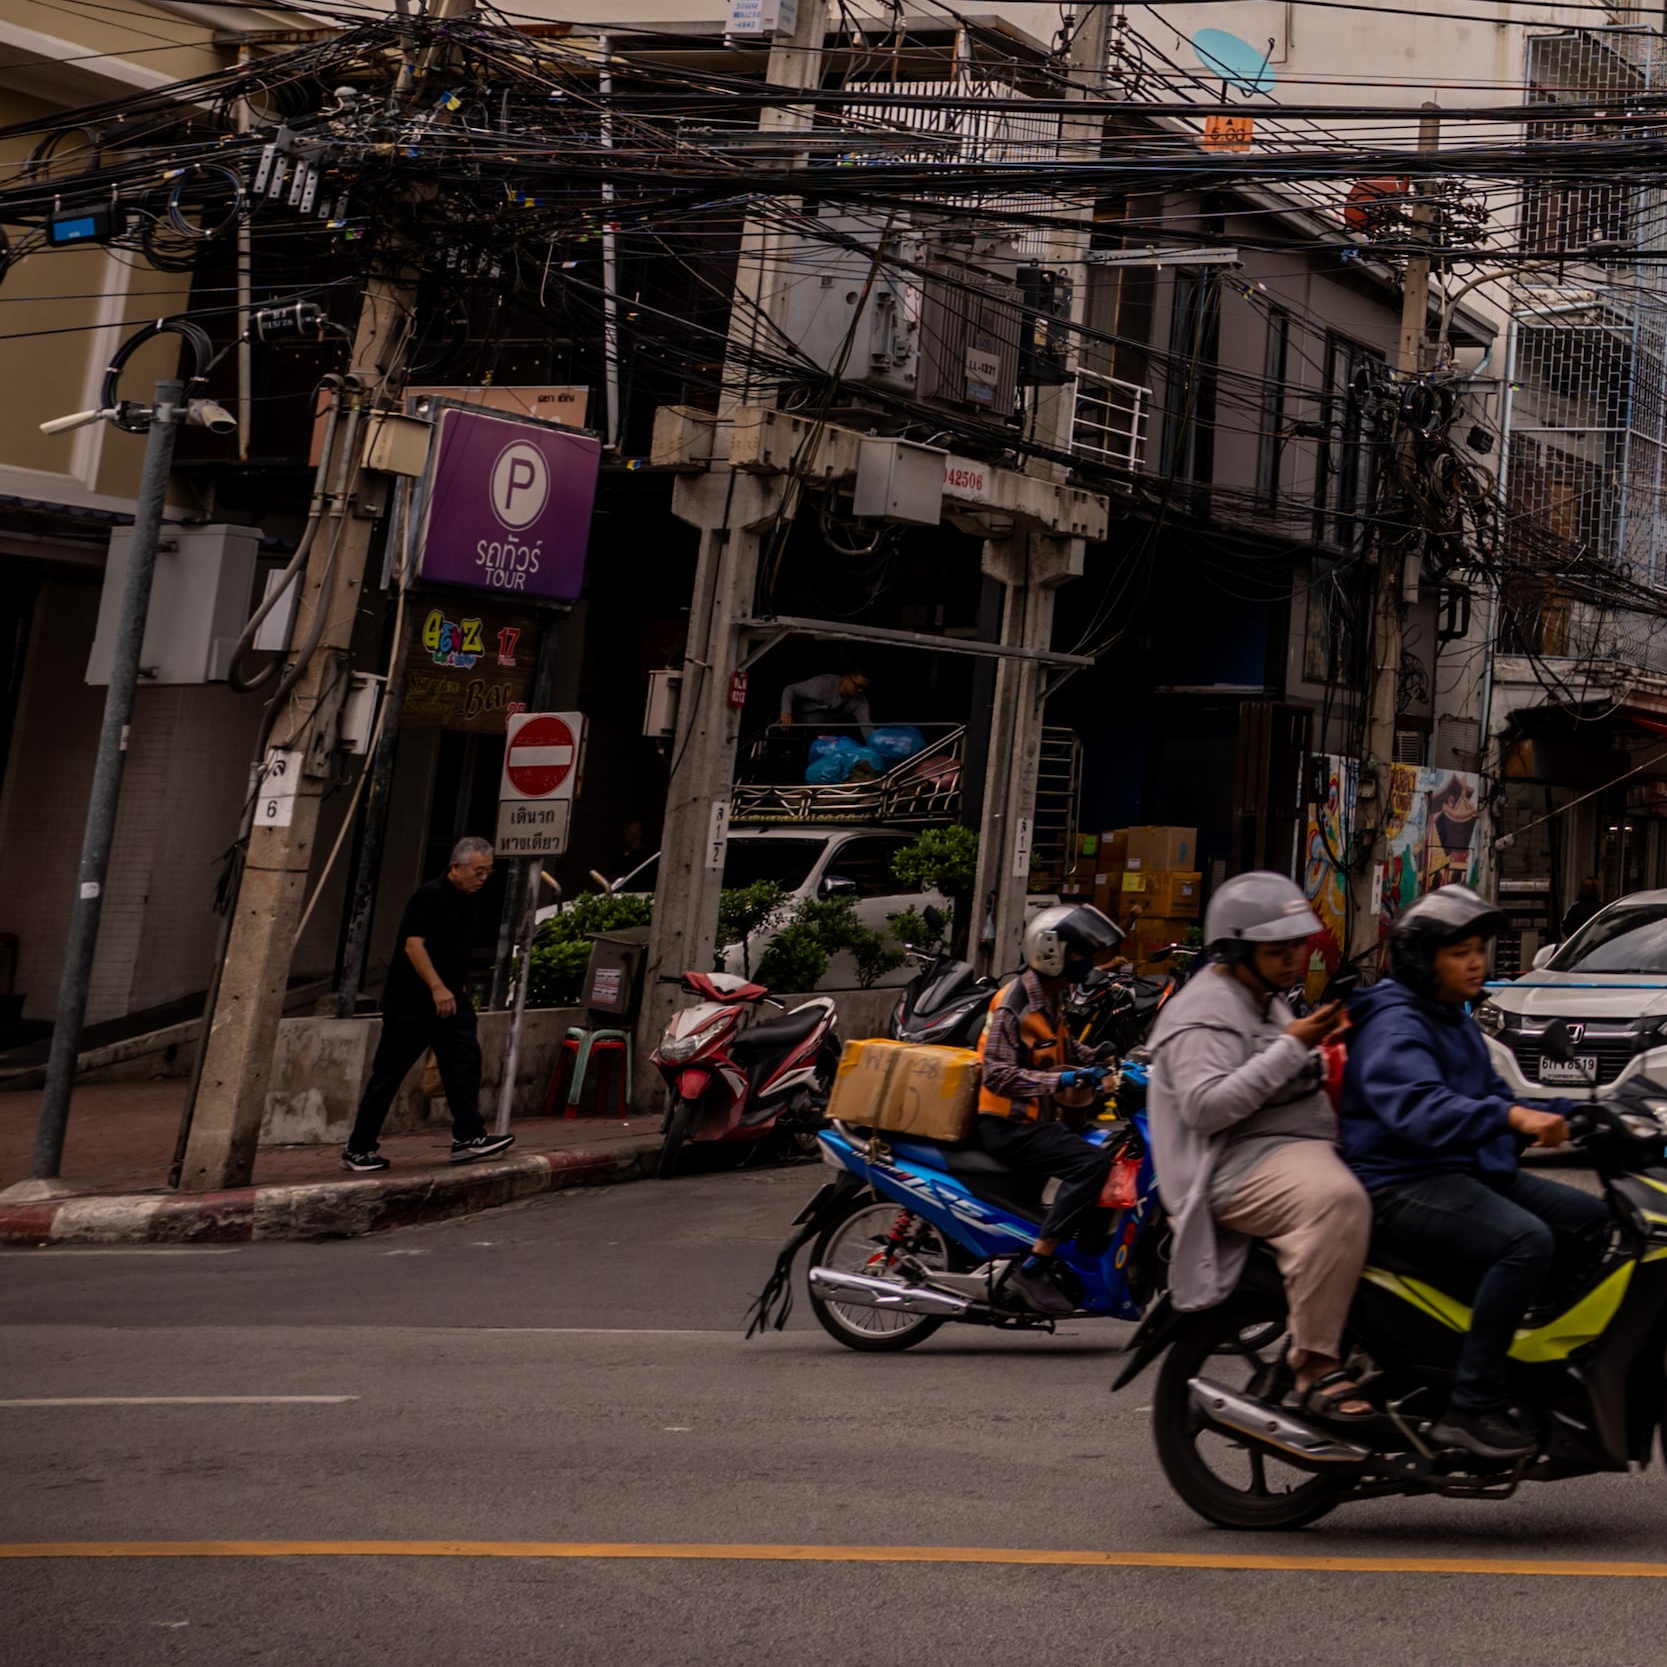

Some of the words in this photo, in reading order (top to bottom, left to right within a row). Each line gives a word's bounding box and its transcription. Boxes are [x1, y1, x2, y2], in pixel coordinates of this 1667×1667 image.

[475, 535, 542, 574] รถทัวร์
[485, 566, 526, 591] TOUR
[497, 627, 521, 657] 17
[267, 800, 278, 818] 6
[511, 807, 556, 826] เดินรถ
[500, 832, 562, 853] ทางเดียว
